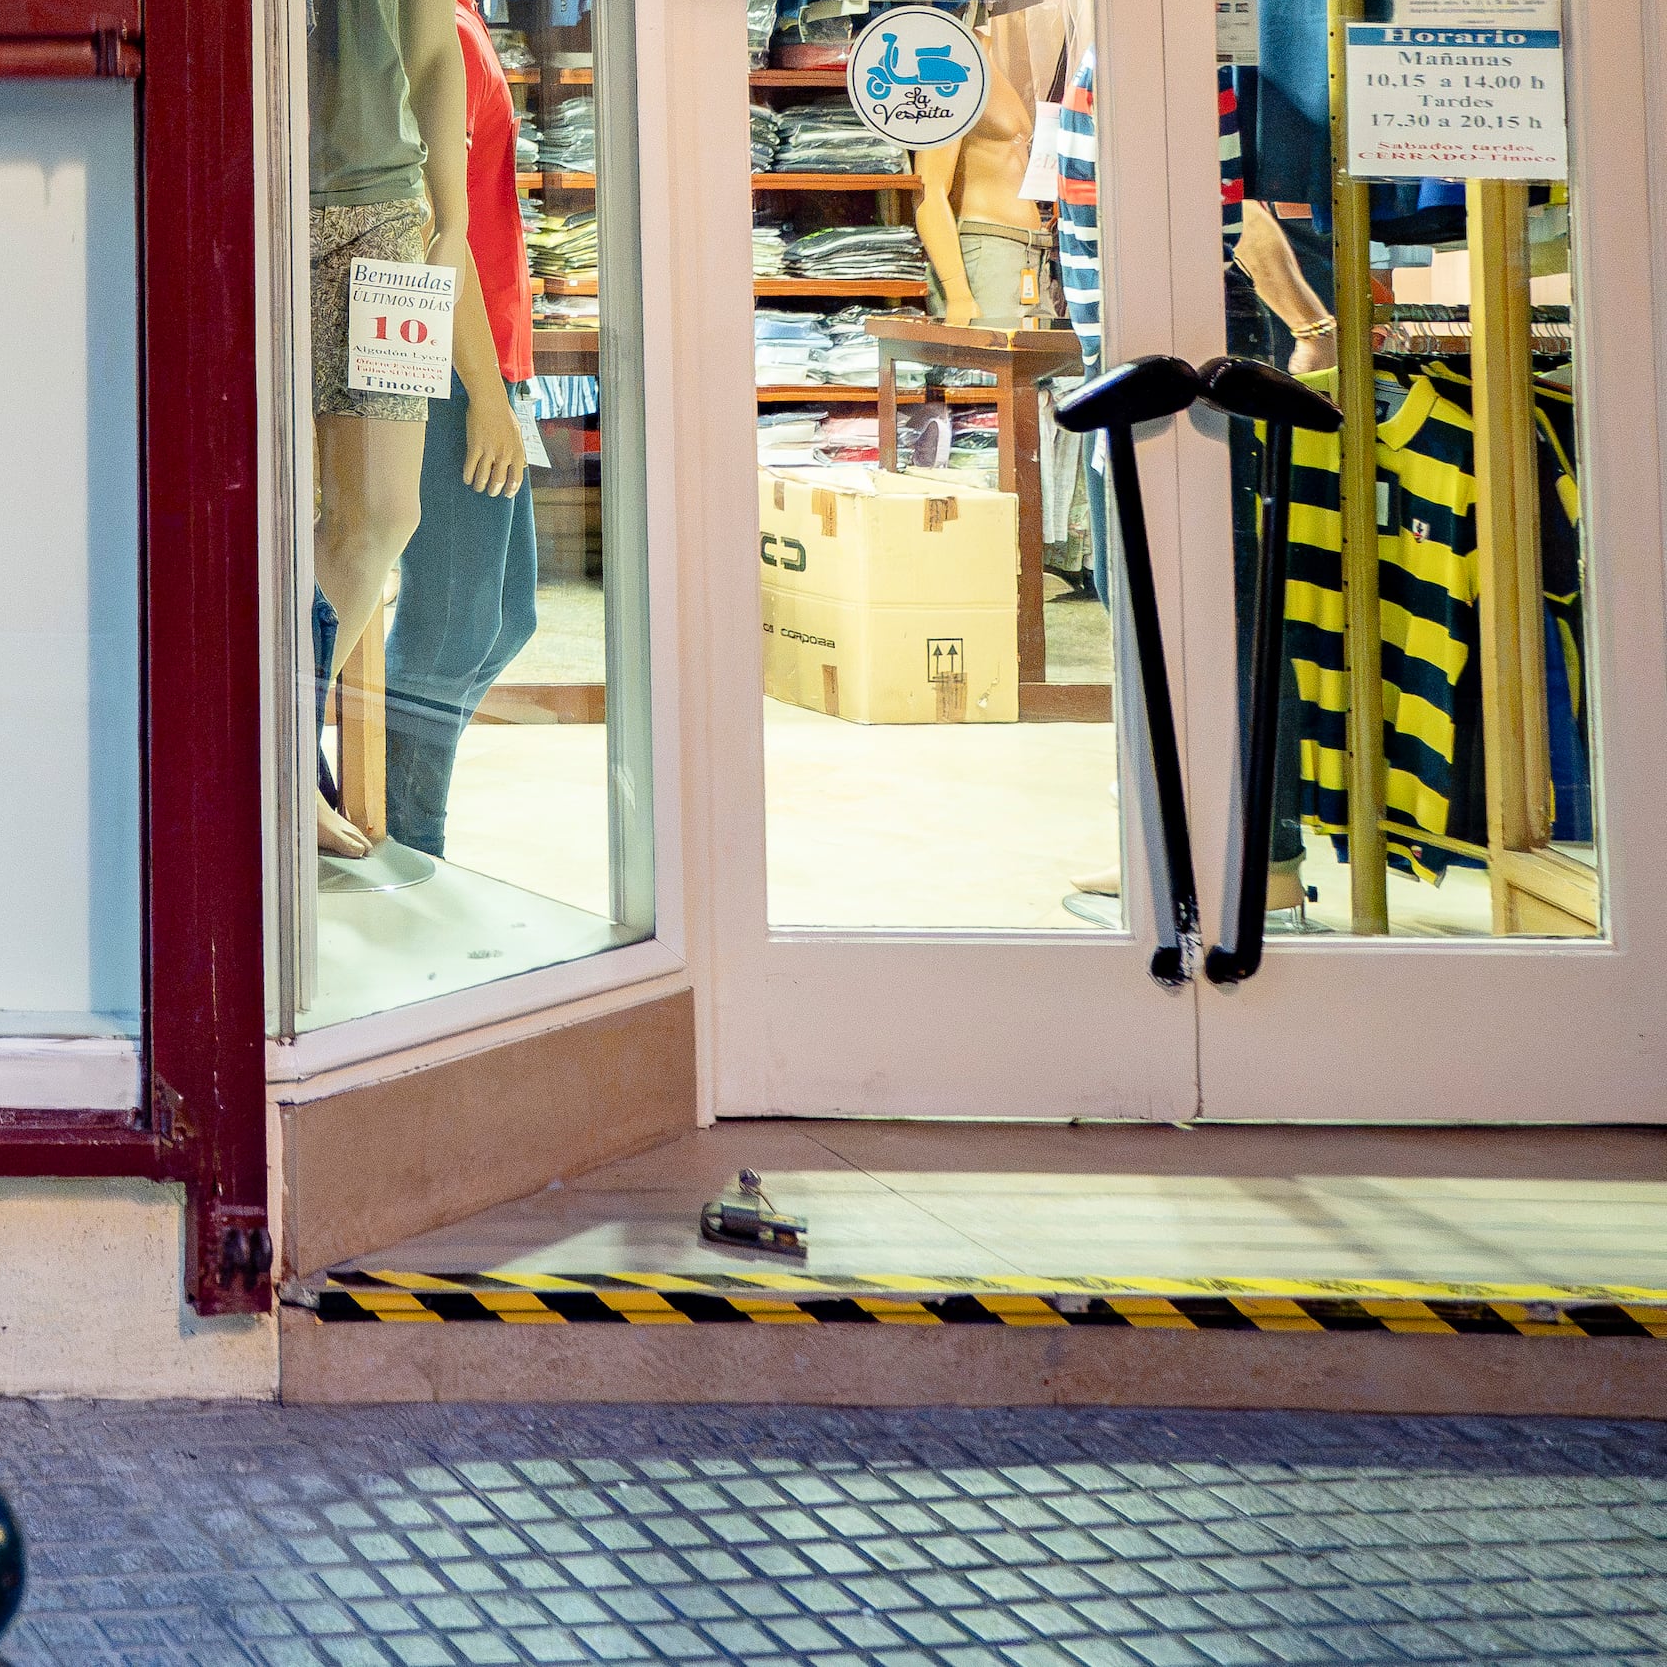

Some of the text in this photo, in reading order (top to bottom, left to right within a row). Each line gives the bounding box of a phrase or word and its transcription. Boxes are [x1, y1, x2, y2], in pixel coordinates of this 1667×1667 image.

[1382, 29, 1526, 44] Horario
[1398, 51, 1513, 67] Mañanas
[1440, 77, 1452, 87] a
[1530, 75, 1545, 89] h
[904, 86, 931, 109] La
[1417, 94, 1494, 108] Tardes
[872, 103, 954, 126] Vespita
[1438, 117, 1451, 127] a
[1528, 116, 1542, 129] h
[354, 264, 452, 292] Bermudas
[353, 287, 452, 312] ÚLTIMOS DÍAS
[353, 344, 448, 362] Algodón Lycra
[361, 375, 436, 395] Tinoco
